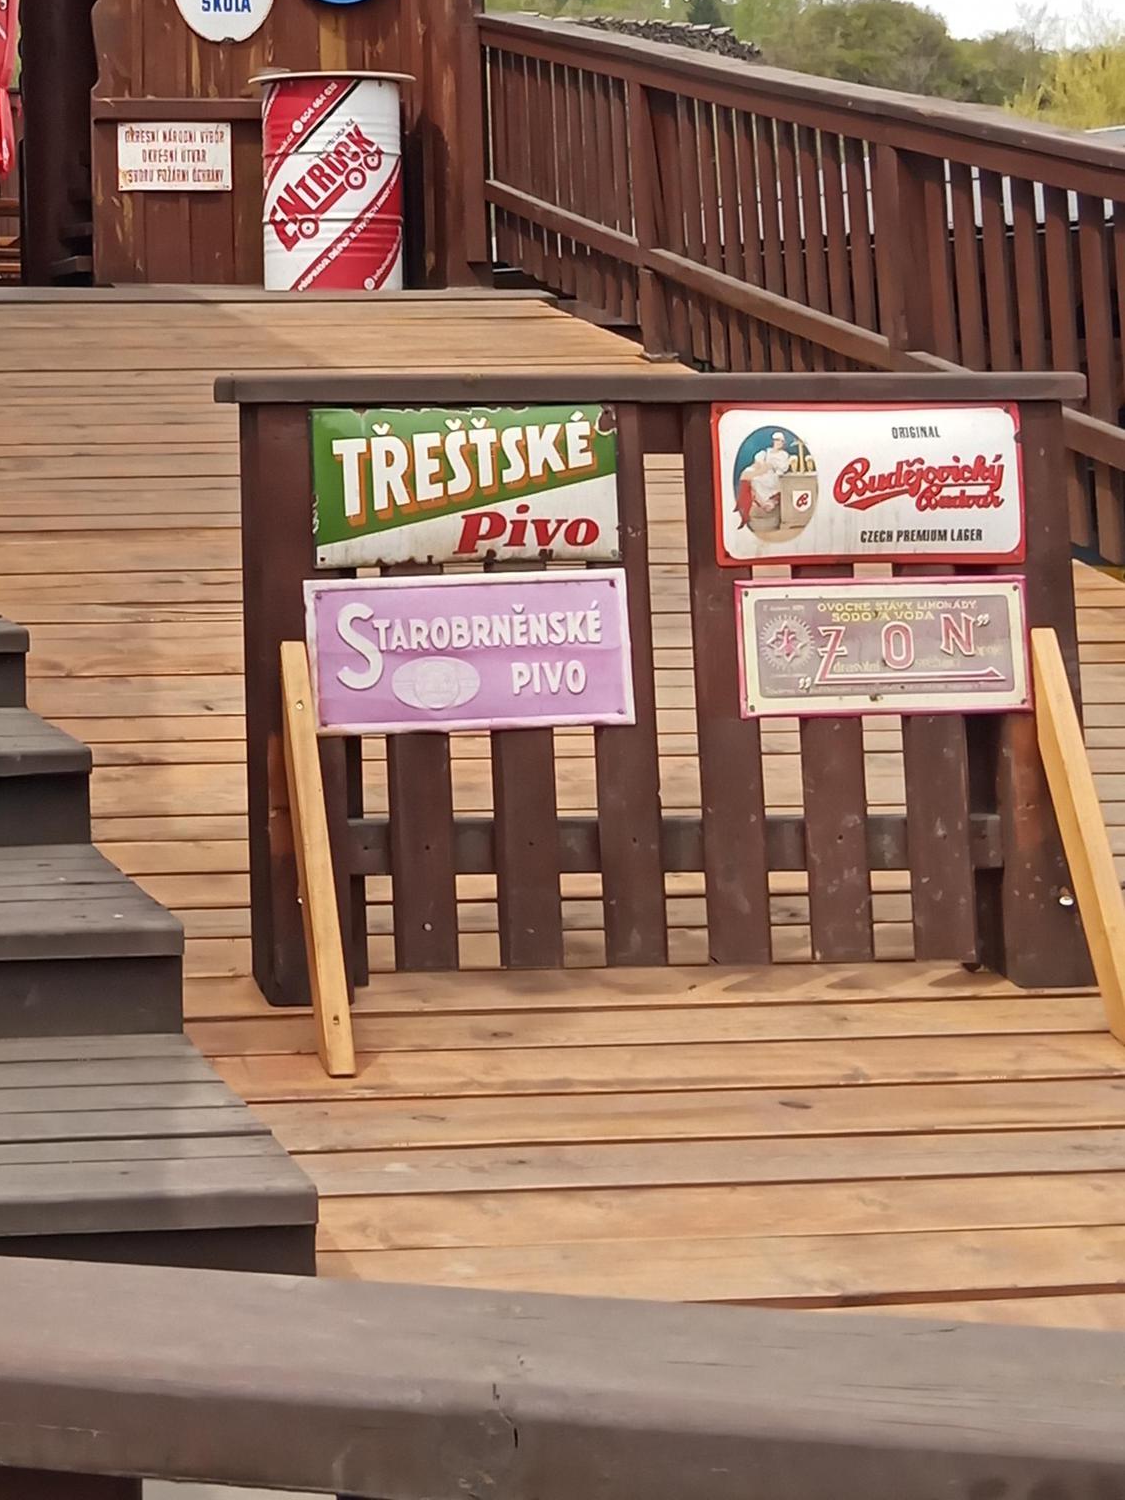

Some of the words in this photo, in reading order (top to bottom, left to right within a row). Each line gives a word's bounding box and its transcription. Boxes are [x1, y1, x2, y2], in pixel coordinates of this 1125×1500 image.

[892, 426, 941, 439] ORIGINAL
[332, 410, 594, 519] TŘEŠŤSKÉ
[833, 453, 1005, 504] Budějovický
[916, 485, 1005, 511] Budvar
[452, 503, 600, 555] Pivo
[860, 529, 893, 543] CZECH
[896, 529, 947, 543] PREMIUM
[950, 528, 983, 542] LAGER
[894, 610, 935, 621] VODA
[336, 601, 602, 690] STAROBRNĚNSKÉ
[510, 659, 587, 695] PIVO
